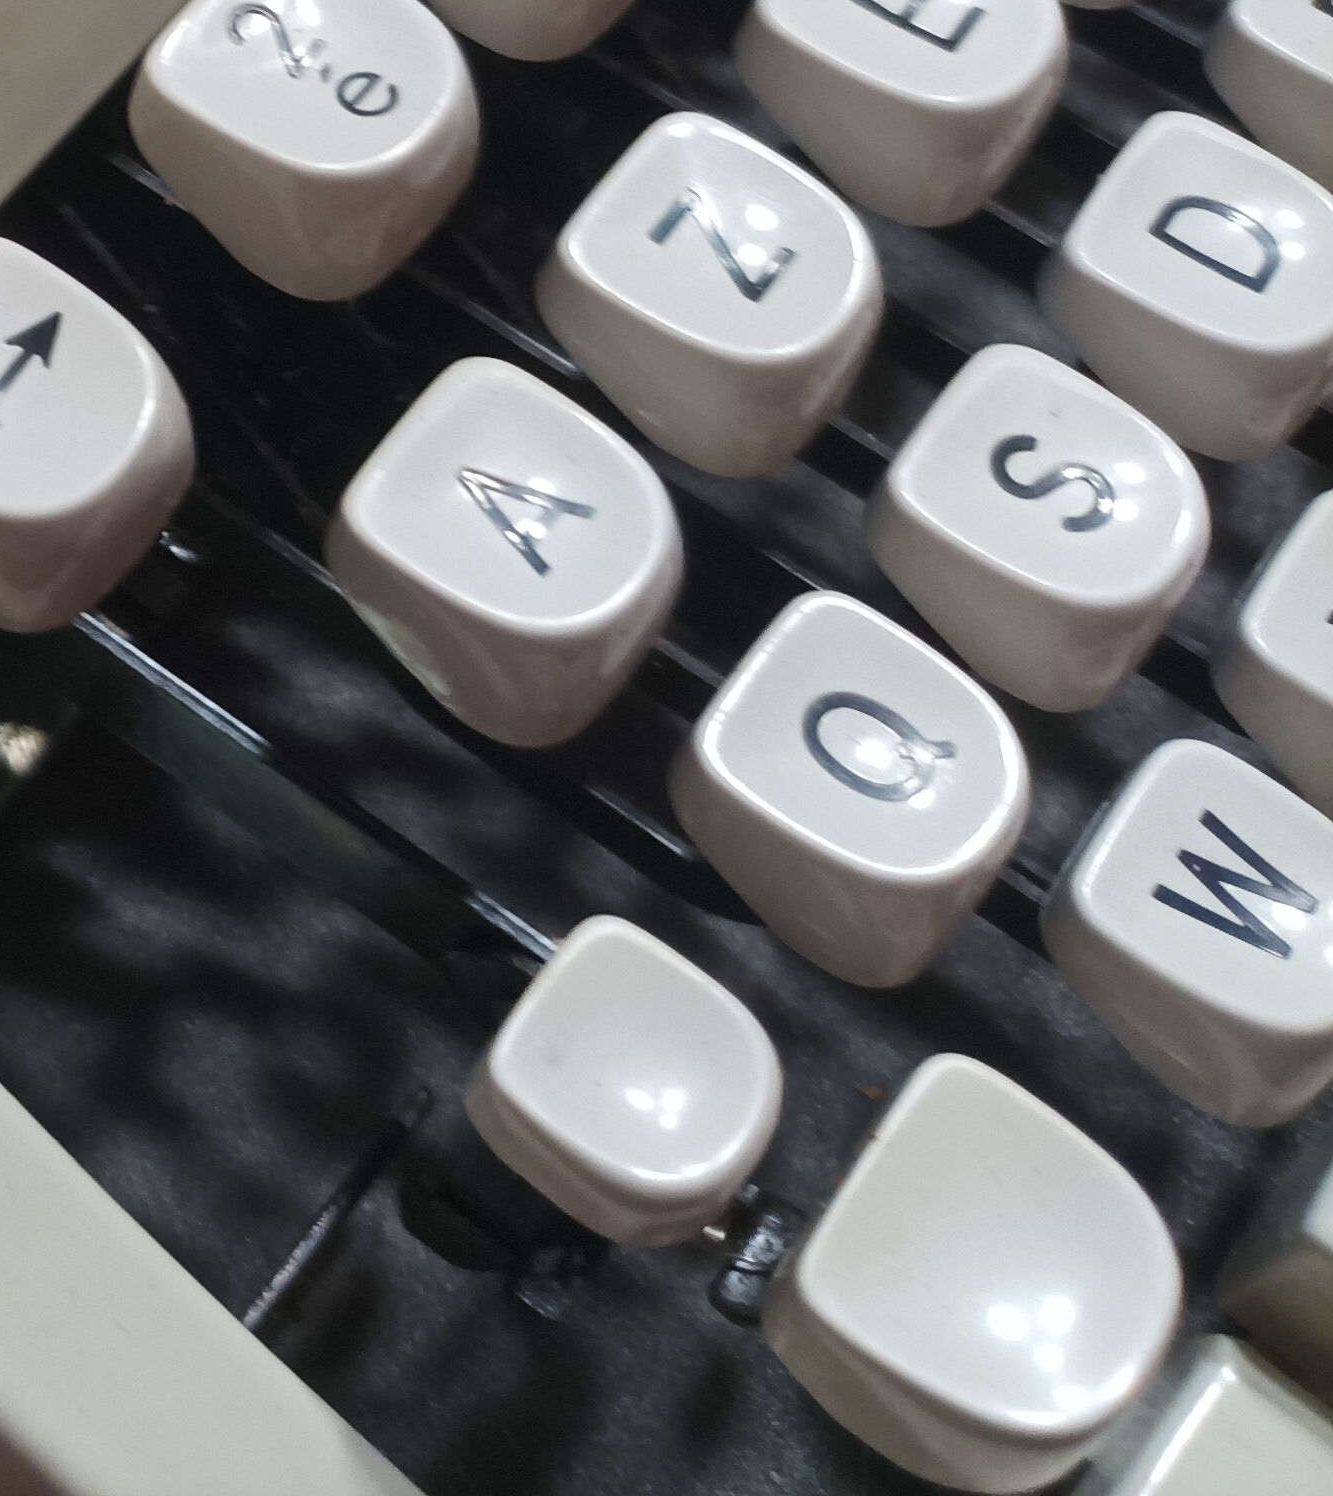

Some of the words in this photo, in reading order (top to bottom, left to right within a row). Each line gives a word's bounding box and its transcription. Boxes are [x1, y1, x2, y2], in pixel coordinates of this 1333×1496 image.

[229, 3, 326, 79] 2
[647, 186, 797, 303] Z
[1149, 194, 1282, 295] D
[454, 466, 596, 577] A
[989, 434, 1116, 533] S
[801, 691, 958, 803] Q
[1151, 808, 1318, 960] W
